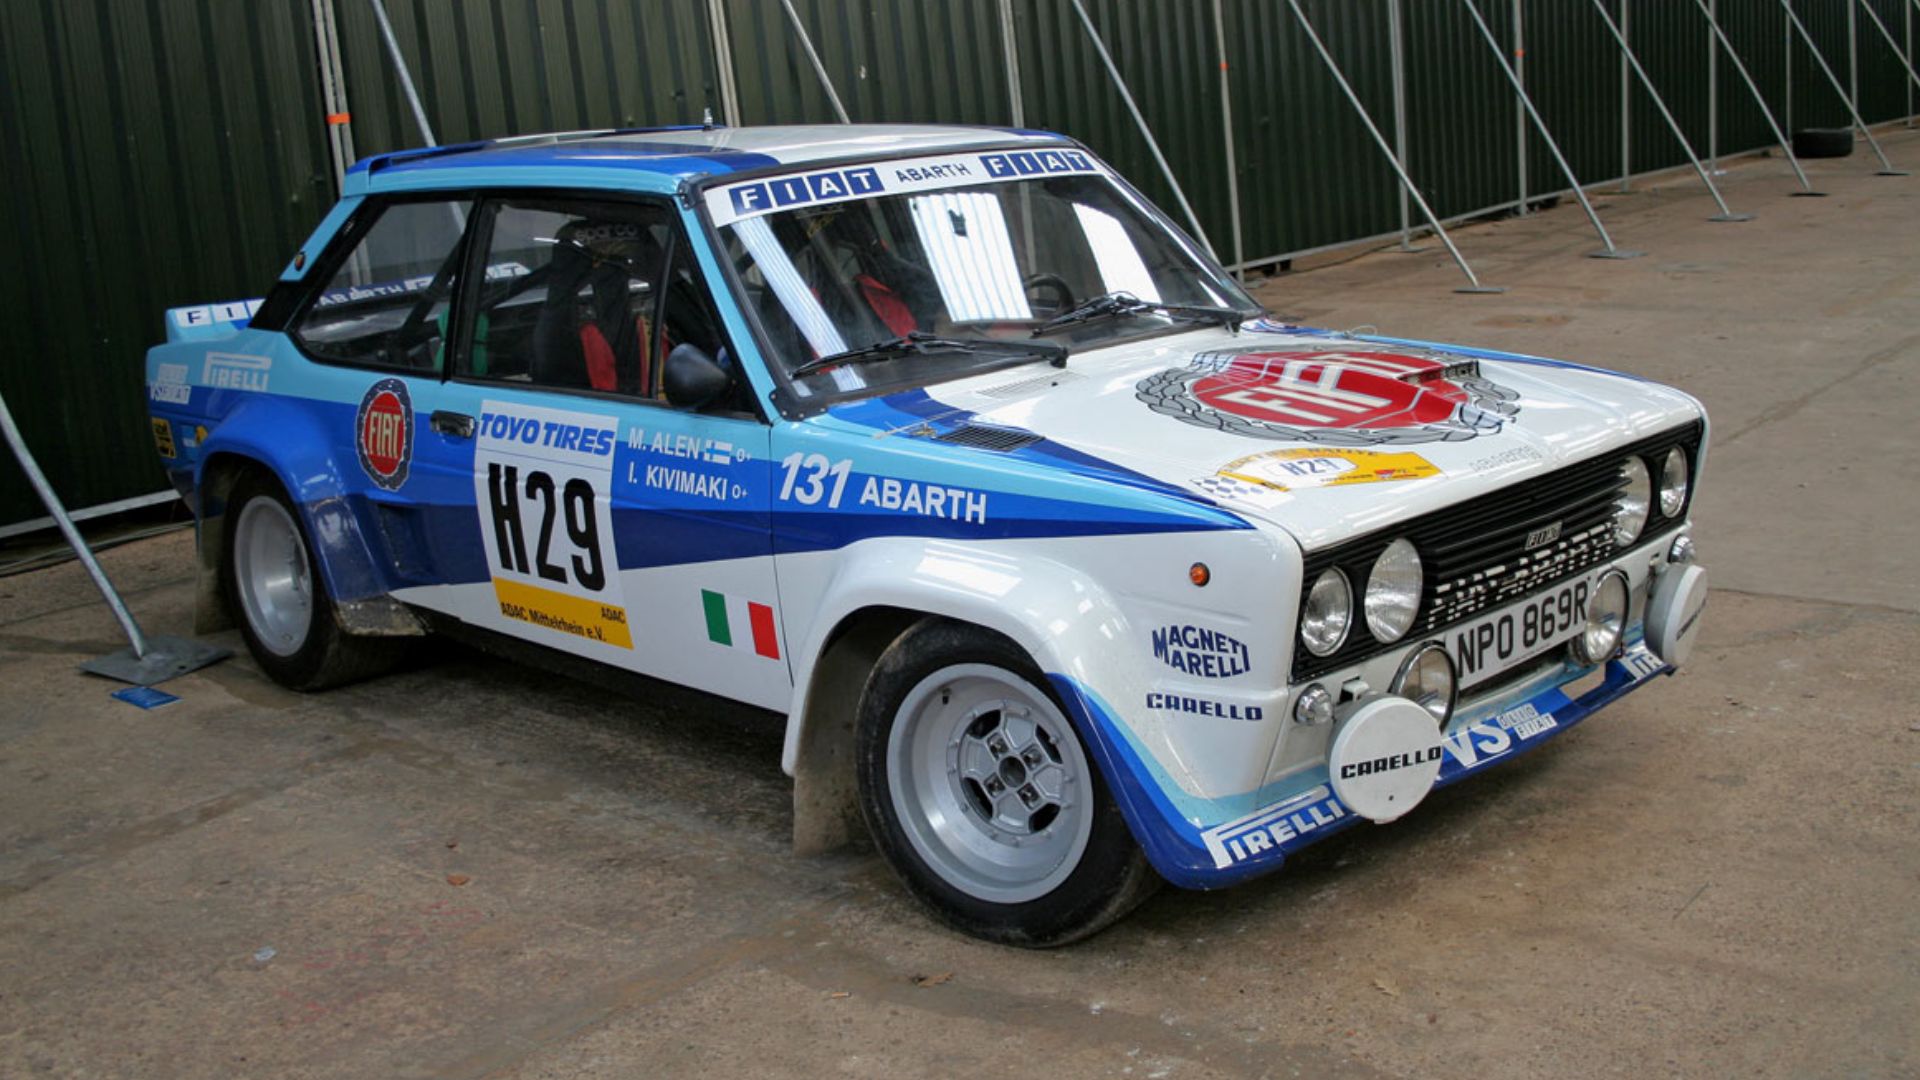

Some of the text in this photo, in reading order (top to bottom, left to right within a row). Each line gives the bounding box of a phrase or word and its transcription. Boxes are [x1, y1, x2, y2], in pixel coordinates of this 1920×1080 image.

[738, 153, 1090, 211] FIAT ABARTH FIAT
[202, 351, 272, 393] PIRELLI
[1211, 352, 1429, 424] FIAT
[368, 410, 401, 460] FIAT
[480, 412, 616, 456] TOYO TIRES
[628, 426, 647, 451] M.
[650, 431, 701, 460] ALEN
[628, 460, 637, 484] I.
[646, 464, 729, 501] KIVIMAKI
[779, 452, 987, 525] 131 ABARTH
[488, 462, 606, 592] H29
[500, 602, 529, 622] ADAC
[528, 609, 586, 637] Mittelrhein
[601, 606, 627, 625] ADAC
[1457, 580, 1589, 681] NPO 869R
[1152, 624, 1250, 672] MAGNETI
[1146, 692, 1263, 721] CARELLO
[1517, 715, 1556, 739] FIAT
[1341, 745, 1441, 780] CARELLO
[1201, 785, 1345, 869] PIRELLI
